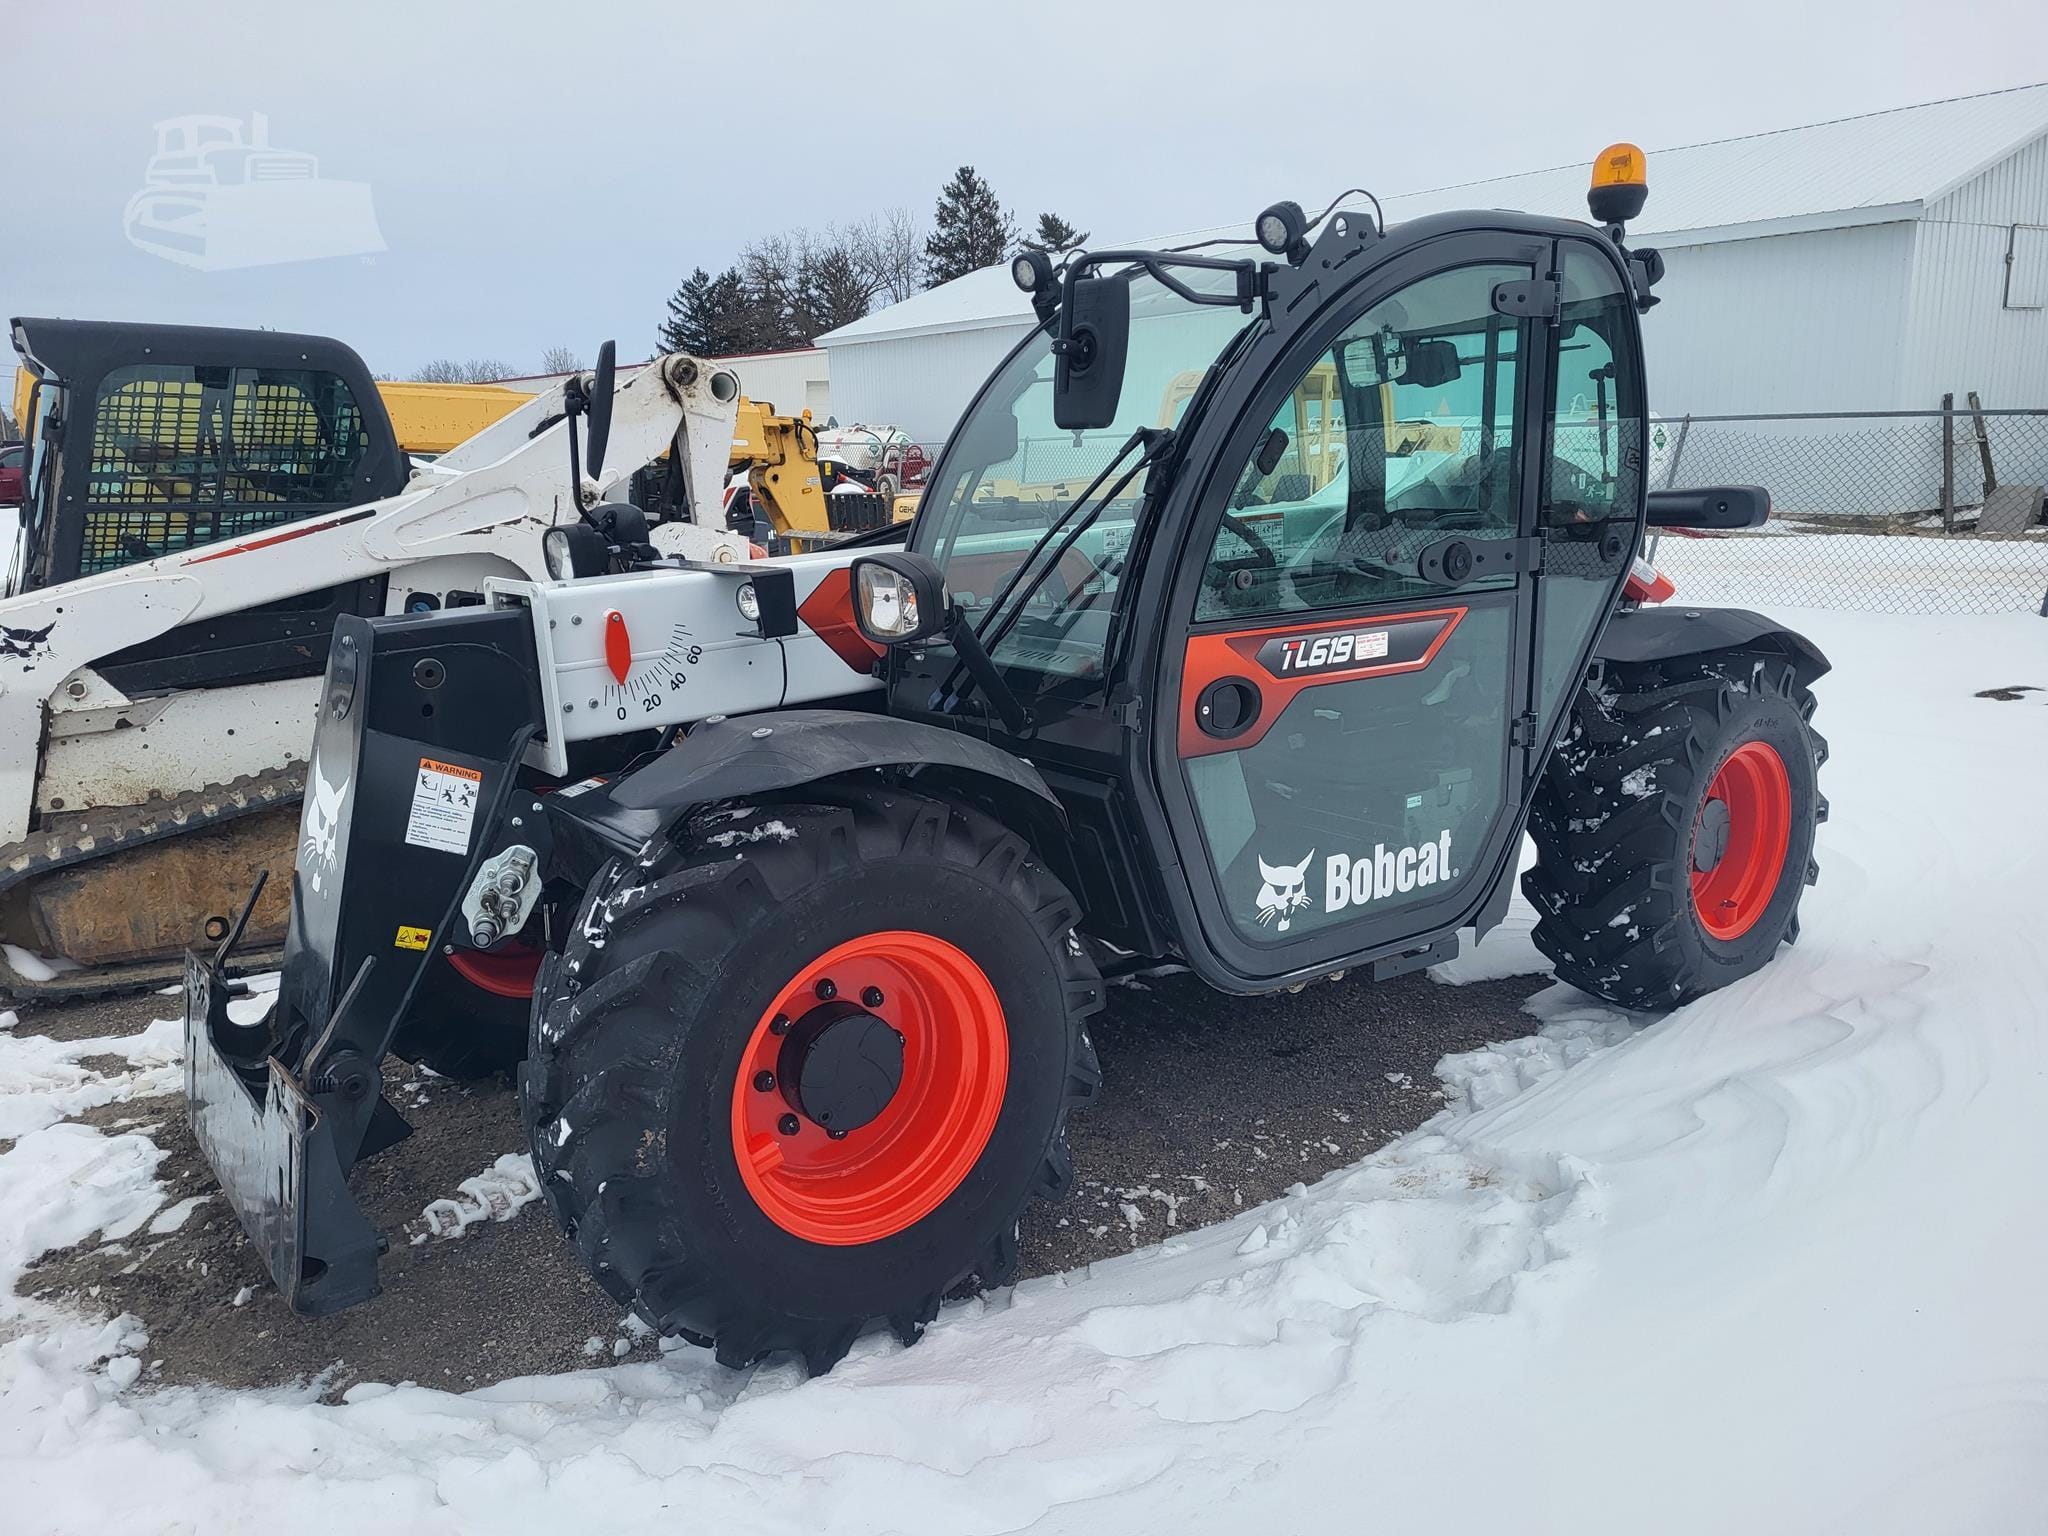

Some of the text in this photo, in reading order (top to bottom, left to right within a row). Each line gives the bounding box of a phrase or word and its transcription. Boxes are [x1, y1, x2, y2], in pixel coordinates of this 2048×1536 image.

[686, 645, 702, 665] 60
[1282, 635, 1355, 670] TL619
[670, 672, 686, 691] 40
[643, 694, 661, 712] 20
[617, 707, 626, 720] 0
[435, 763, 478, 780] WARNING
[1325, 829, 1452, 913] Bobcat
